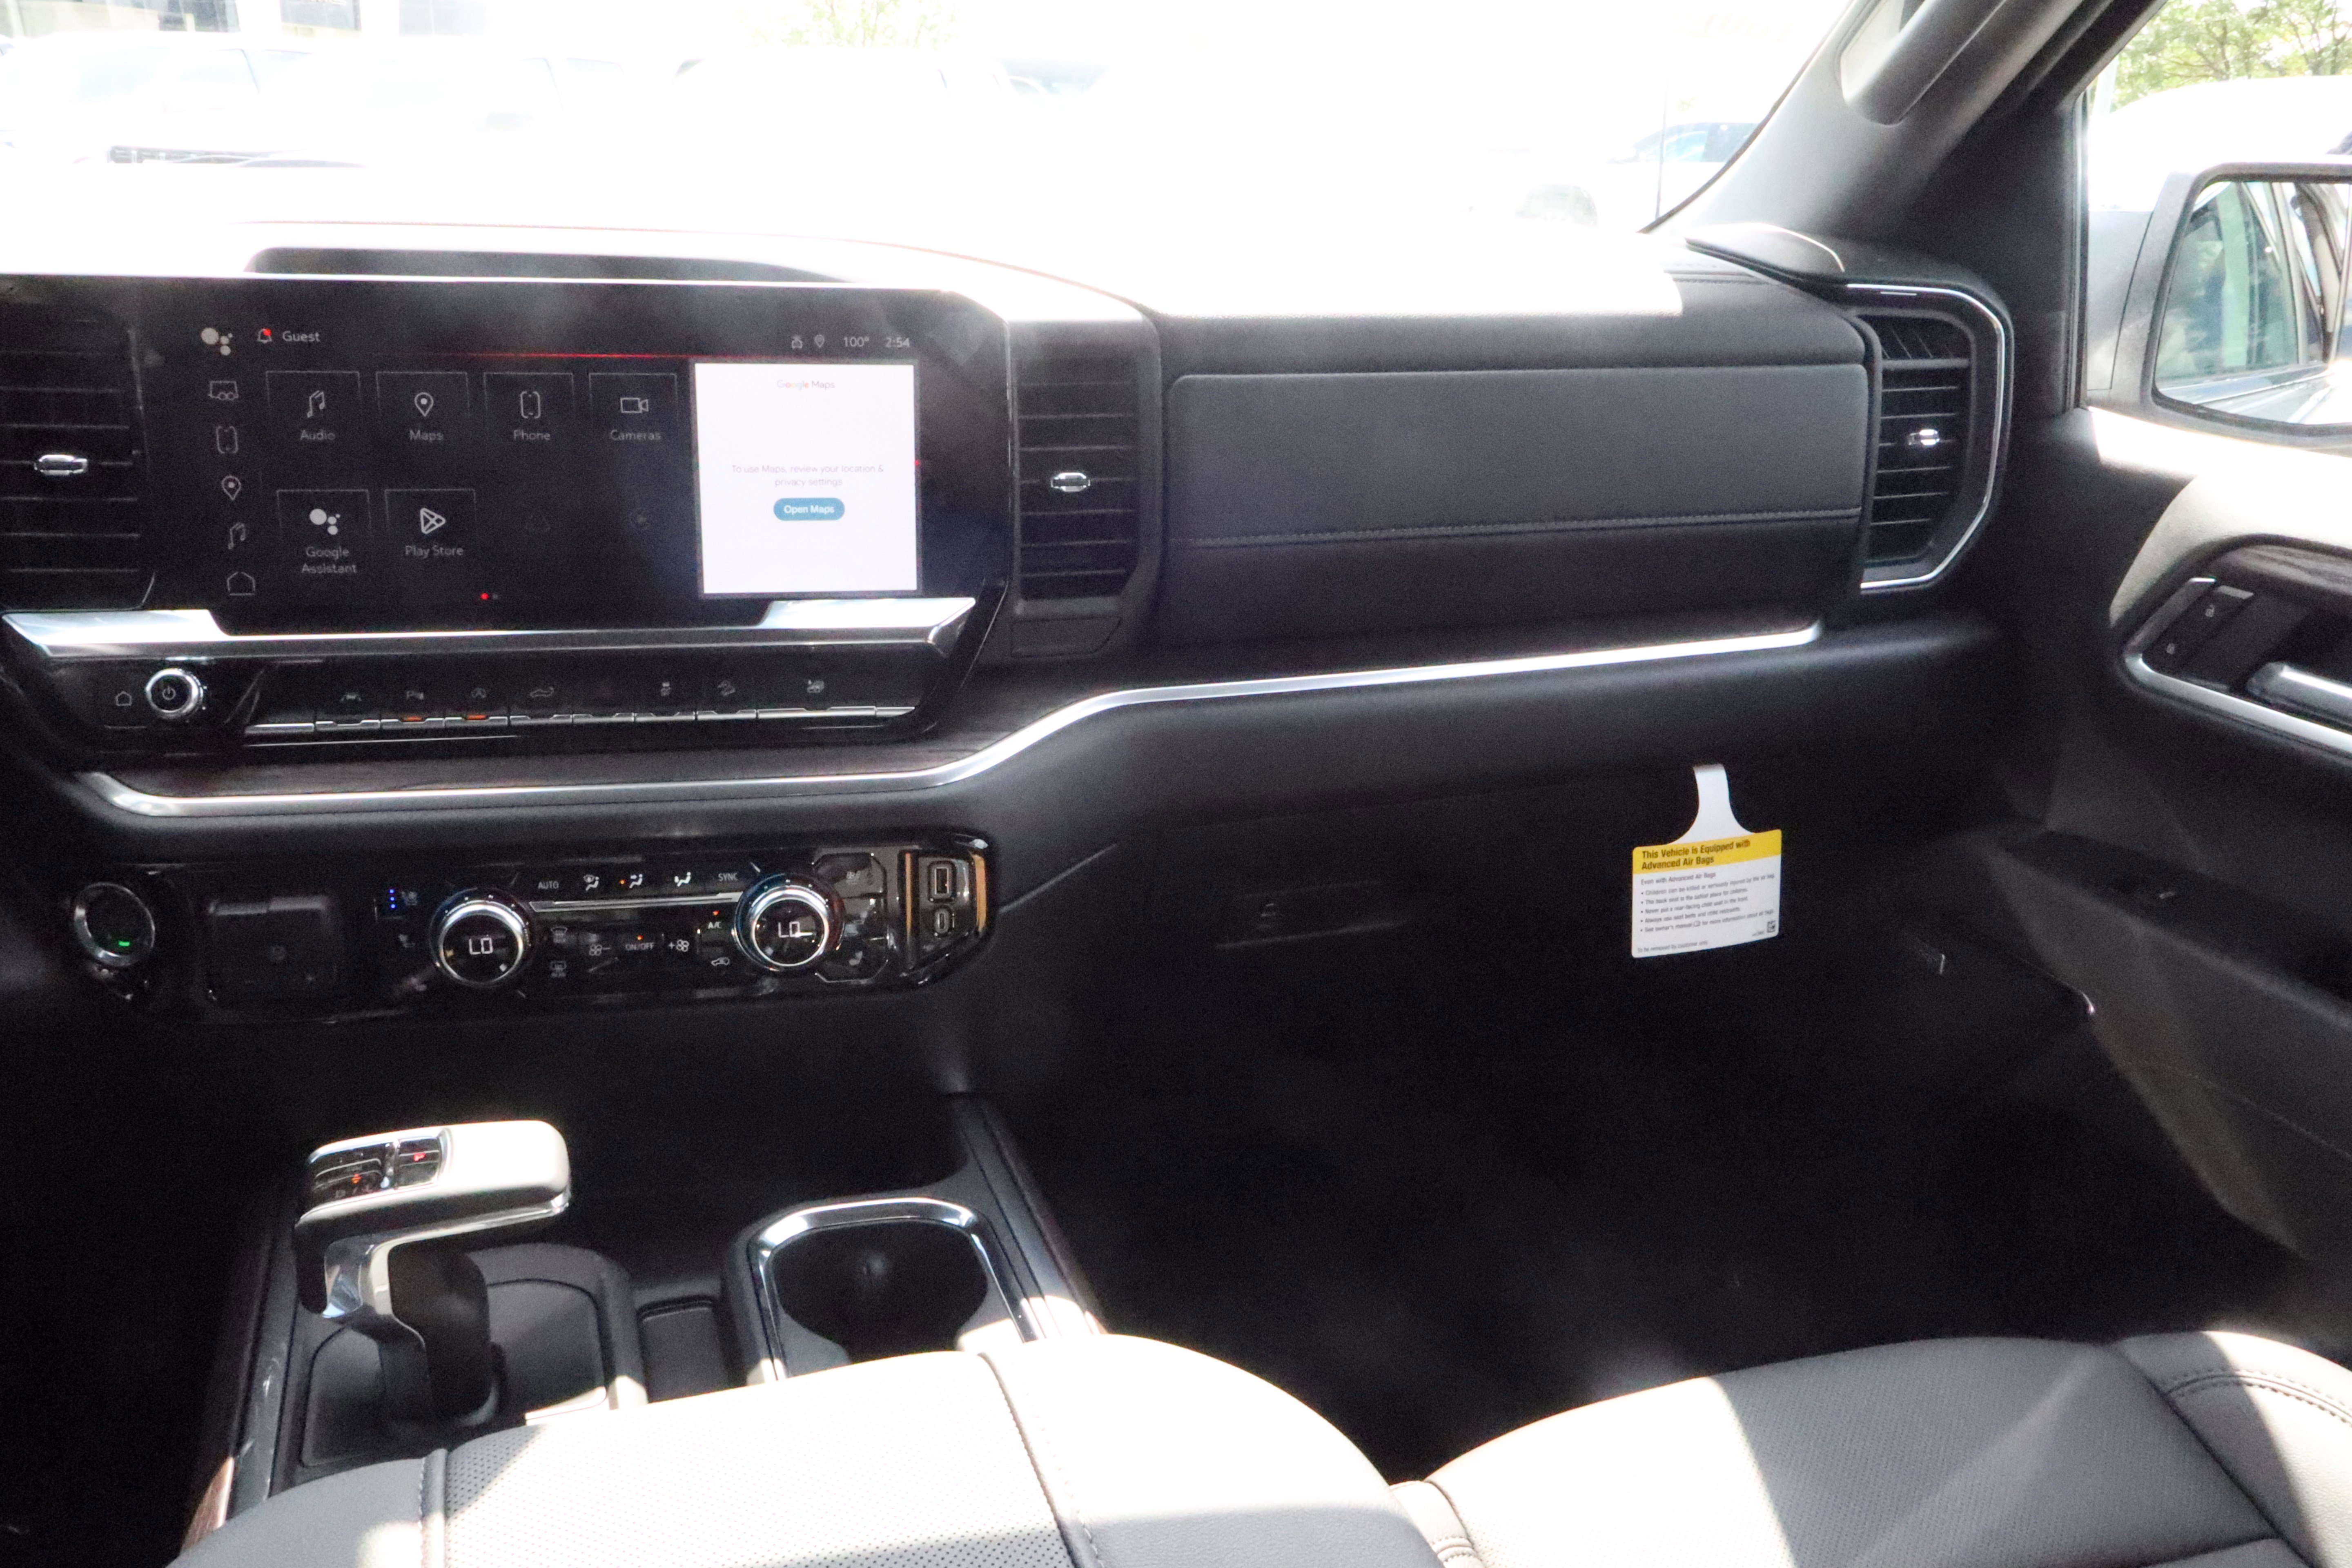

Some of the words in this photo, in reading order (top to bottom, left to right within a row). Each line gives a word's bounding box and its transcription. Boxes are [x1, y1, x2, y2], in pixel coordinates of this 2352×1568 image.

[282, 330, 321, 342] Guest
[844, 336, 870, 347] 100°
[885, 337, 910, 347] 2:54
[777, 380, 809, 390] Google
[811, 381, 835, 390] Maps
[300, 430, 336, 441] Audio
[409, 430, 444, 442] Maps
[513, 429, 551, 441] Phone
[610, 429, 662, 441] Cameras
[731, 465, 742, 473] To
[762, 465, 788, 474] Maps,
[820, 466, 838, 474] your
[841, 465, 875, 473] location
[775, 479, 806, 488] privacy
[808, 478, 843, 487] settings
[783, 505, 808, 515] Open
[810, 504, 835, 514] Maps
[305, 546, 350, 560] Google
[405, 545, 430, 558] Play
[432, 545, 464, 556] Store
[301, 563, 357, 573] Assistant
[1642, 850, 1659, 859] This
[1661, 847, 1690, 858] Vehicle
[1692, 846, 1698, 854] is
[1700, 842, 1734, 854] Equipped
[1735, 839, 1751, 849] with
[1642, 859, 1681, 870] Advanced
[1683, 858, 1693, 866] Air
[1696, 856, 1714, 865] Bags
[718, 873, 738, 881] SYNC
[538, 881, 559, 890] AUTO
[708, 921, 722, 930] A/C
[468, 938, 493, 955] LO
[624, 942, 655, 951] ON/OFF
